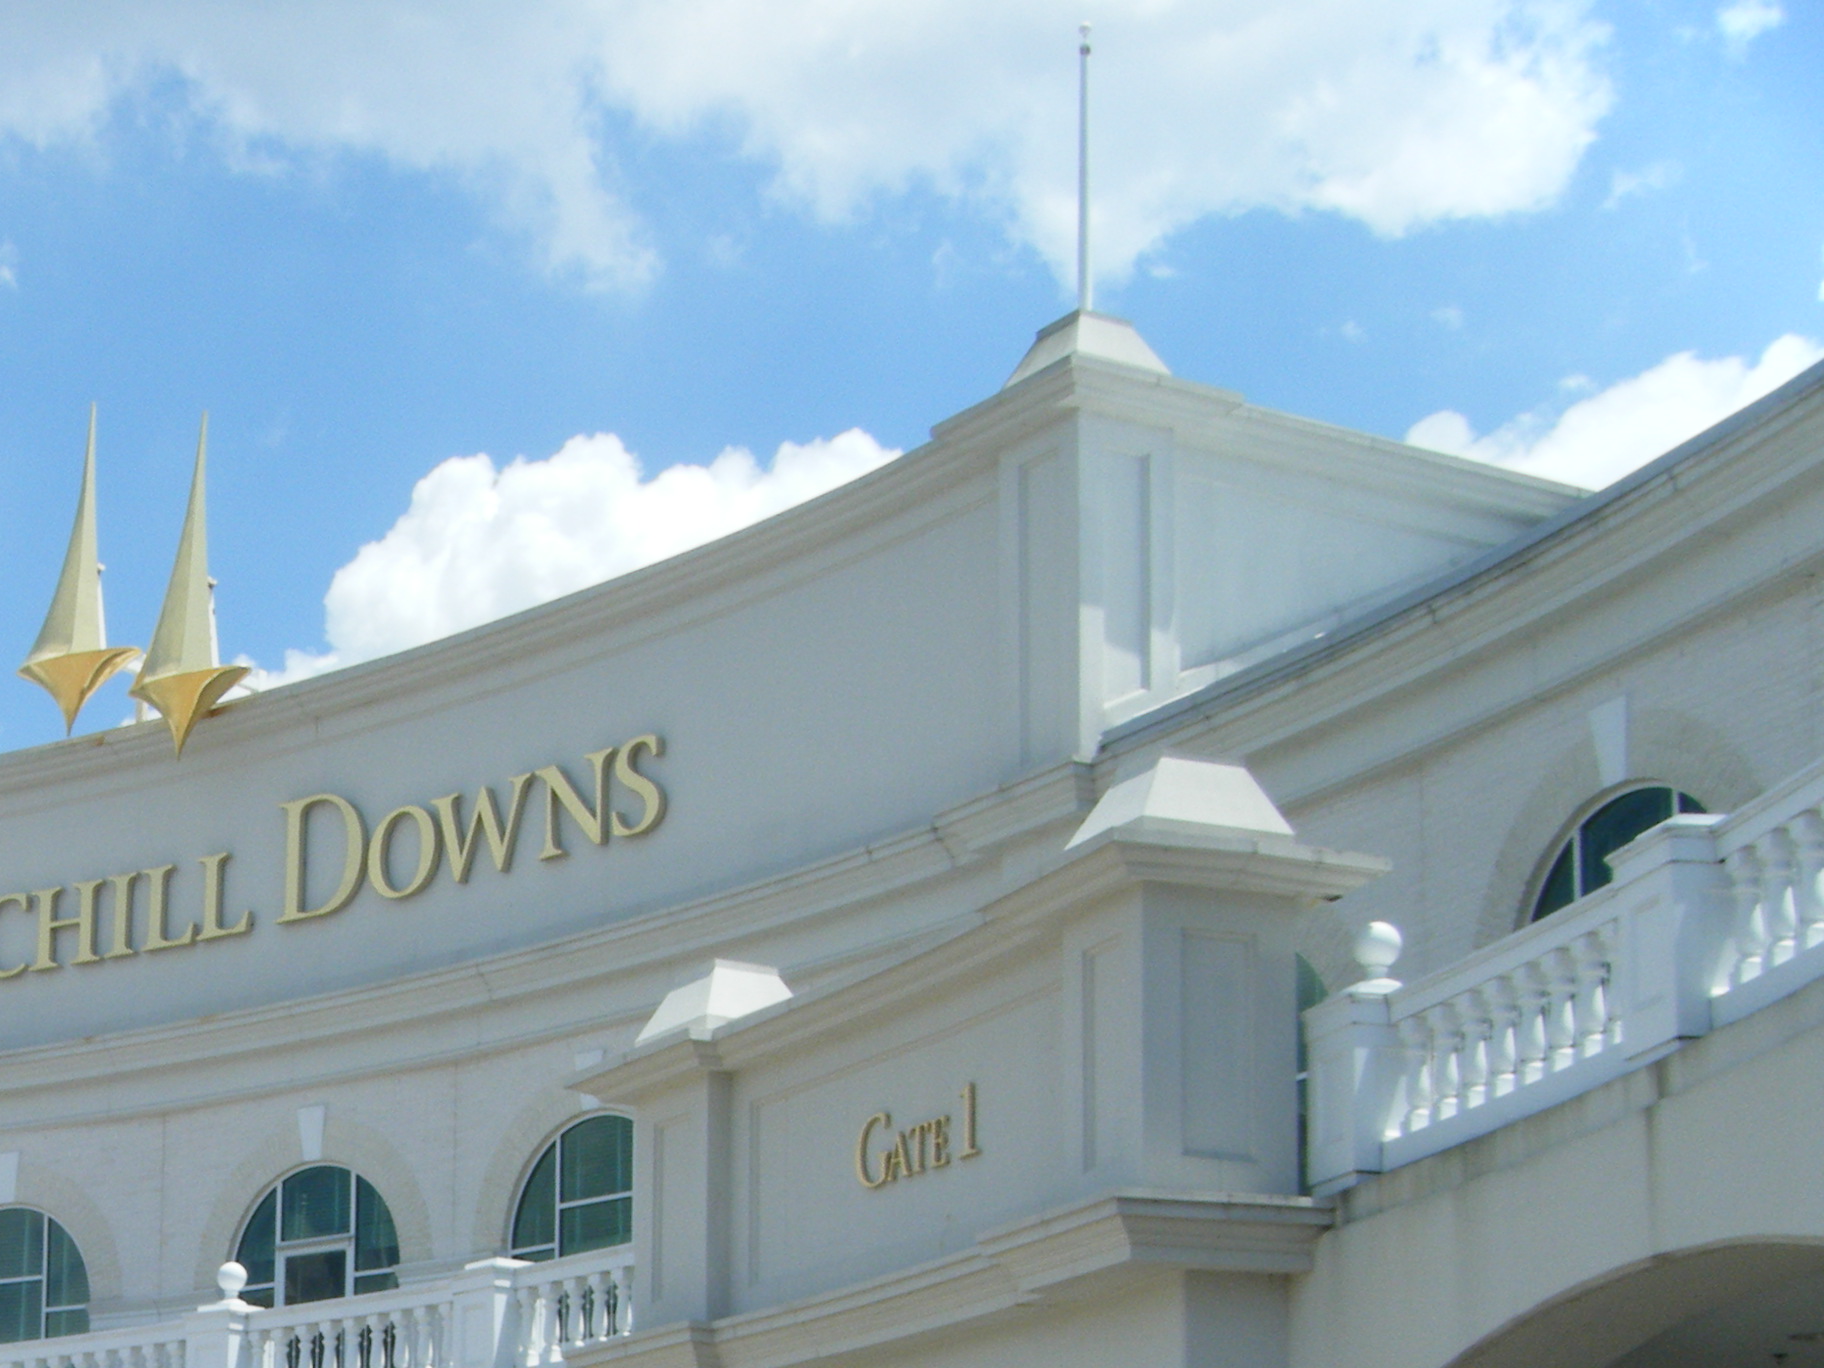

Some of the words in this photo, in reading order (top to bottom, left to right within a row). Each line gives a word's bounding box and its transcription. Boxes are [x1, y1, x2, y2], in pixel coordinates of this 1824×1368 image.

[276, 733, 666, 925] DOWNS
[857, 1112, 951, 1189] GATE
[960, 1082, 982, 1160] 1
